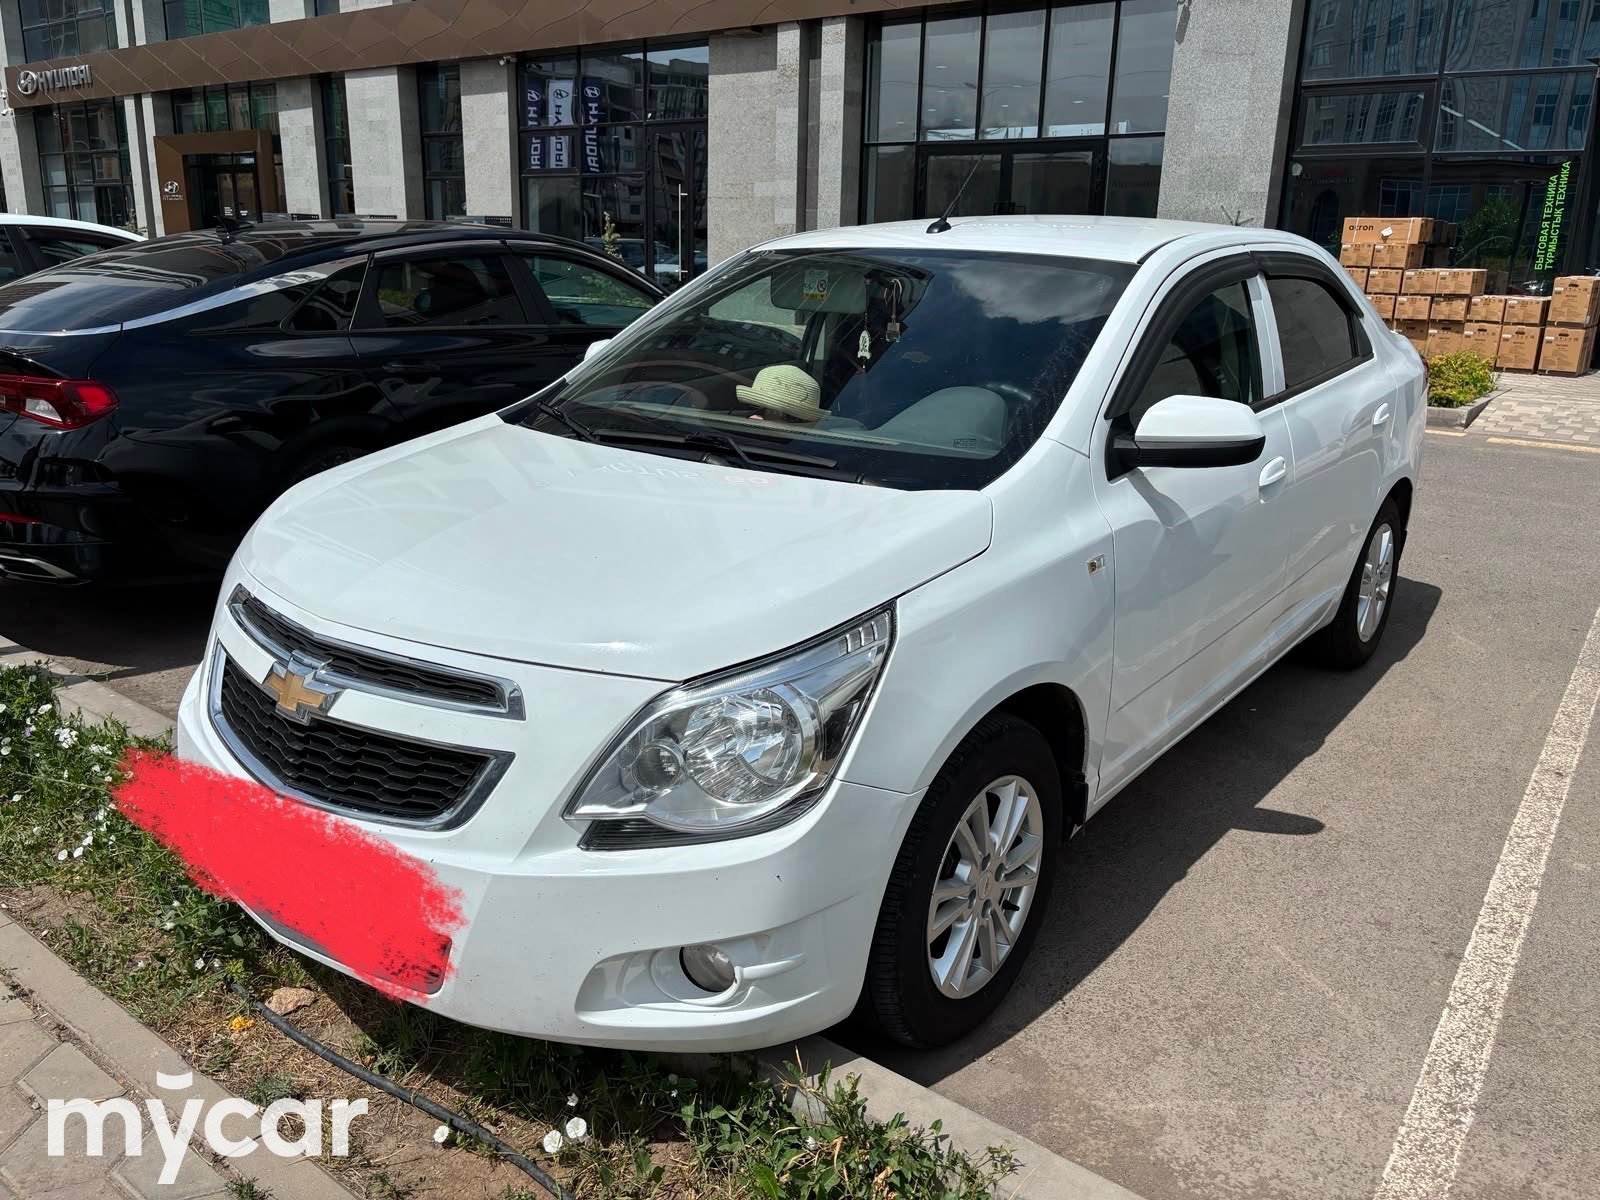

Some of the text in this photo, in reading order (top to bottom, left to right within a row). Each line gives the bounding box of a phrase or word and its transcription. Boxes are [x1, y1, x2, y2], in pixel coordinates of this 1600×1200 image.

[38, 65, 92, 91] HYUNDAI
[1555, 160, 1571, 206] ТЕХНИКА
[1534, 174, 1559, 270] БЫТОВАЯ ТЕХНИКА
